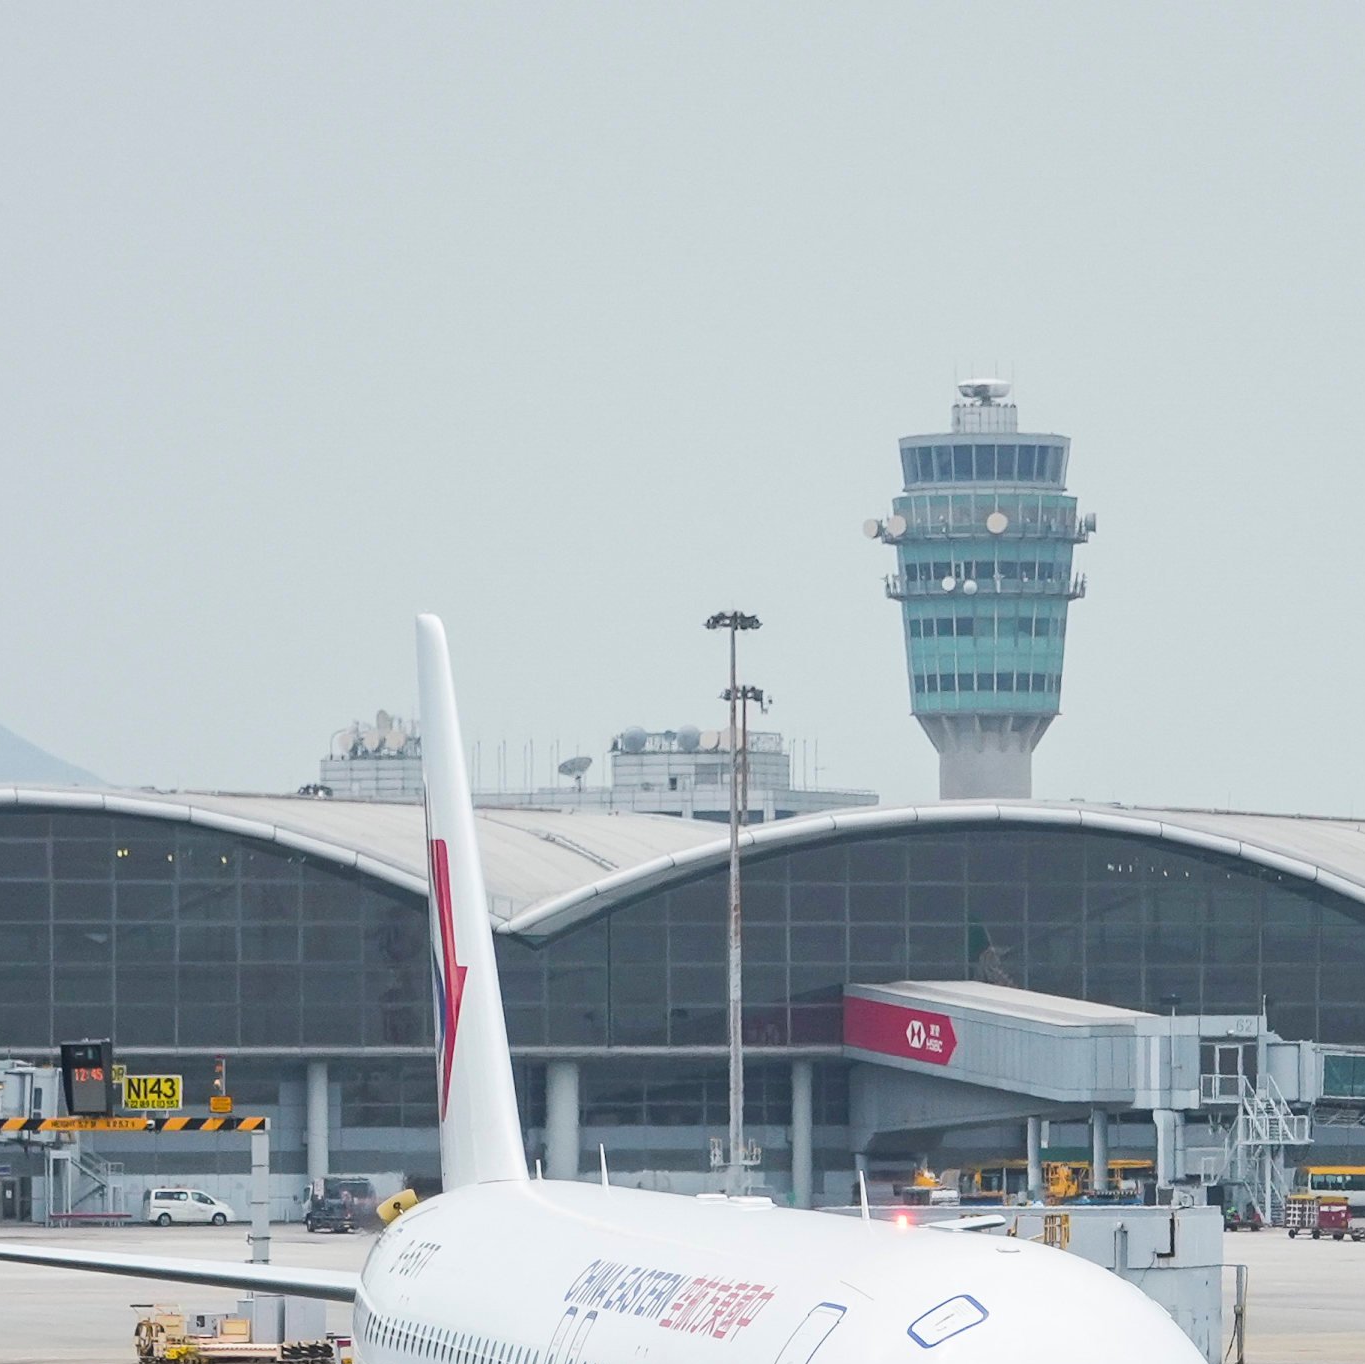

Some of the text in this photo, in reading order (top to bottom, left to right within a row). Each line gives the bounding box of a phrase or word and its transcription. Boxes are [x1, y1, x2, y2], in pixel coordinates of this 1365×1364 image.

[925, 1037, 943, 1053] HSBC
[74, 1067, 103, 1081] 12:45
[127, 1077, 176, 1099] N143
[564, 1259, 692, 1319] CHINA EASTERN
